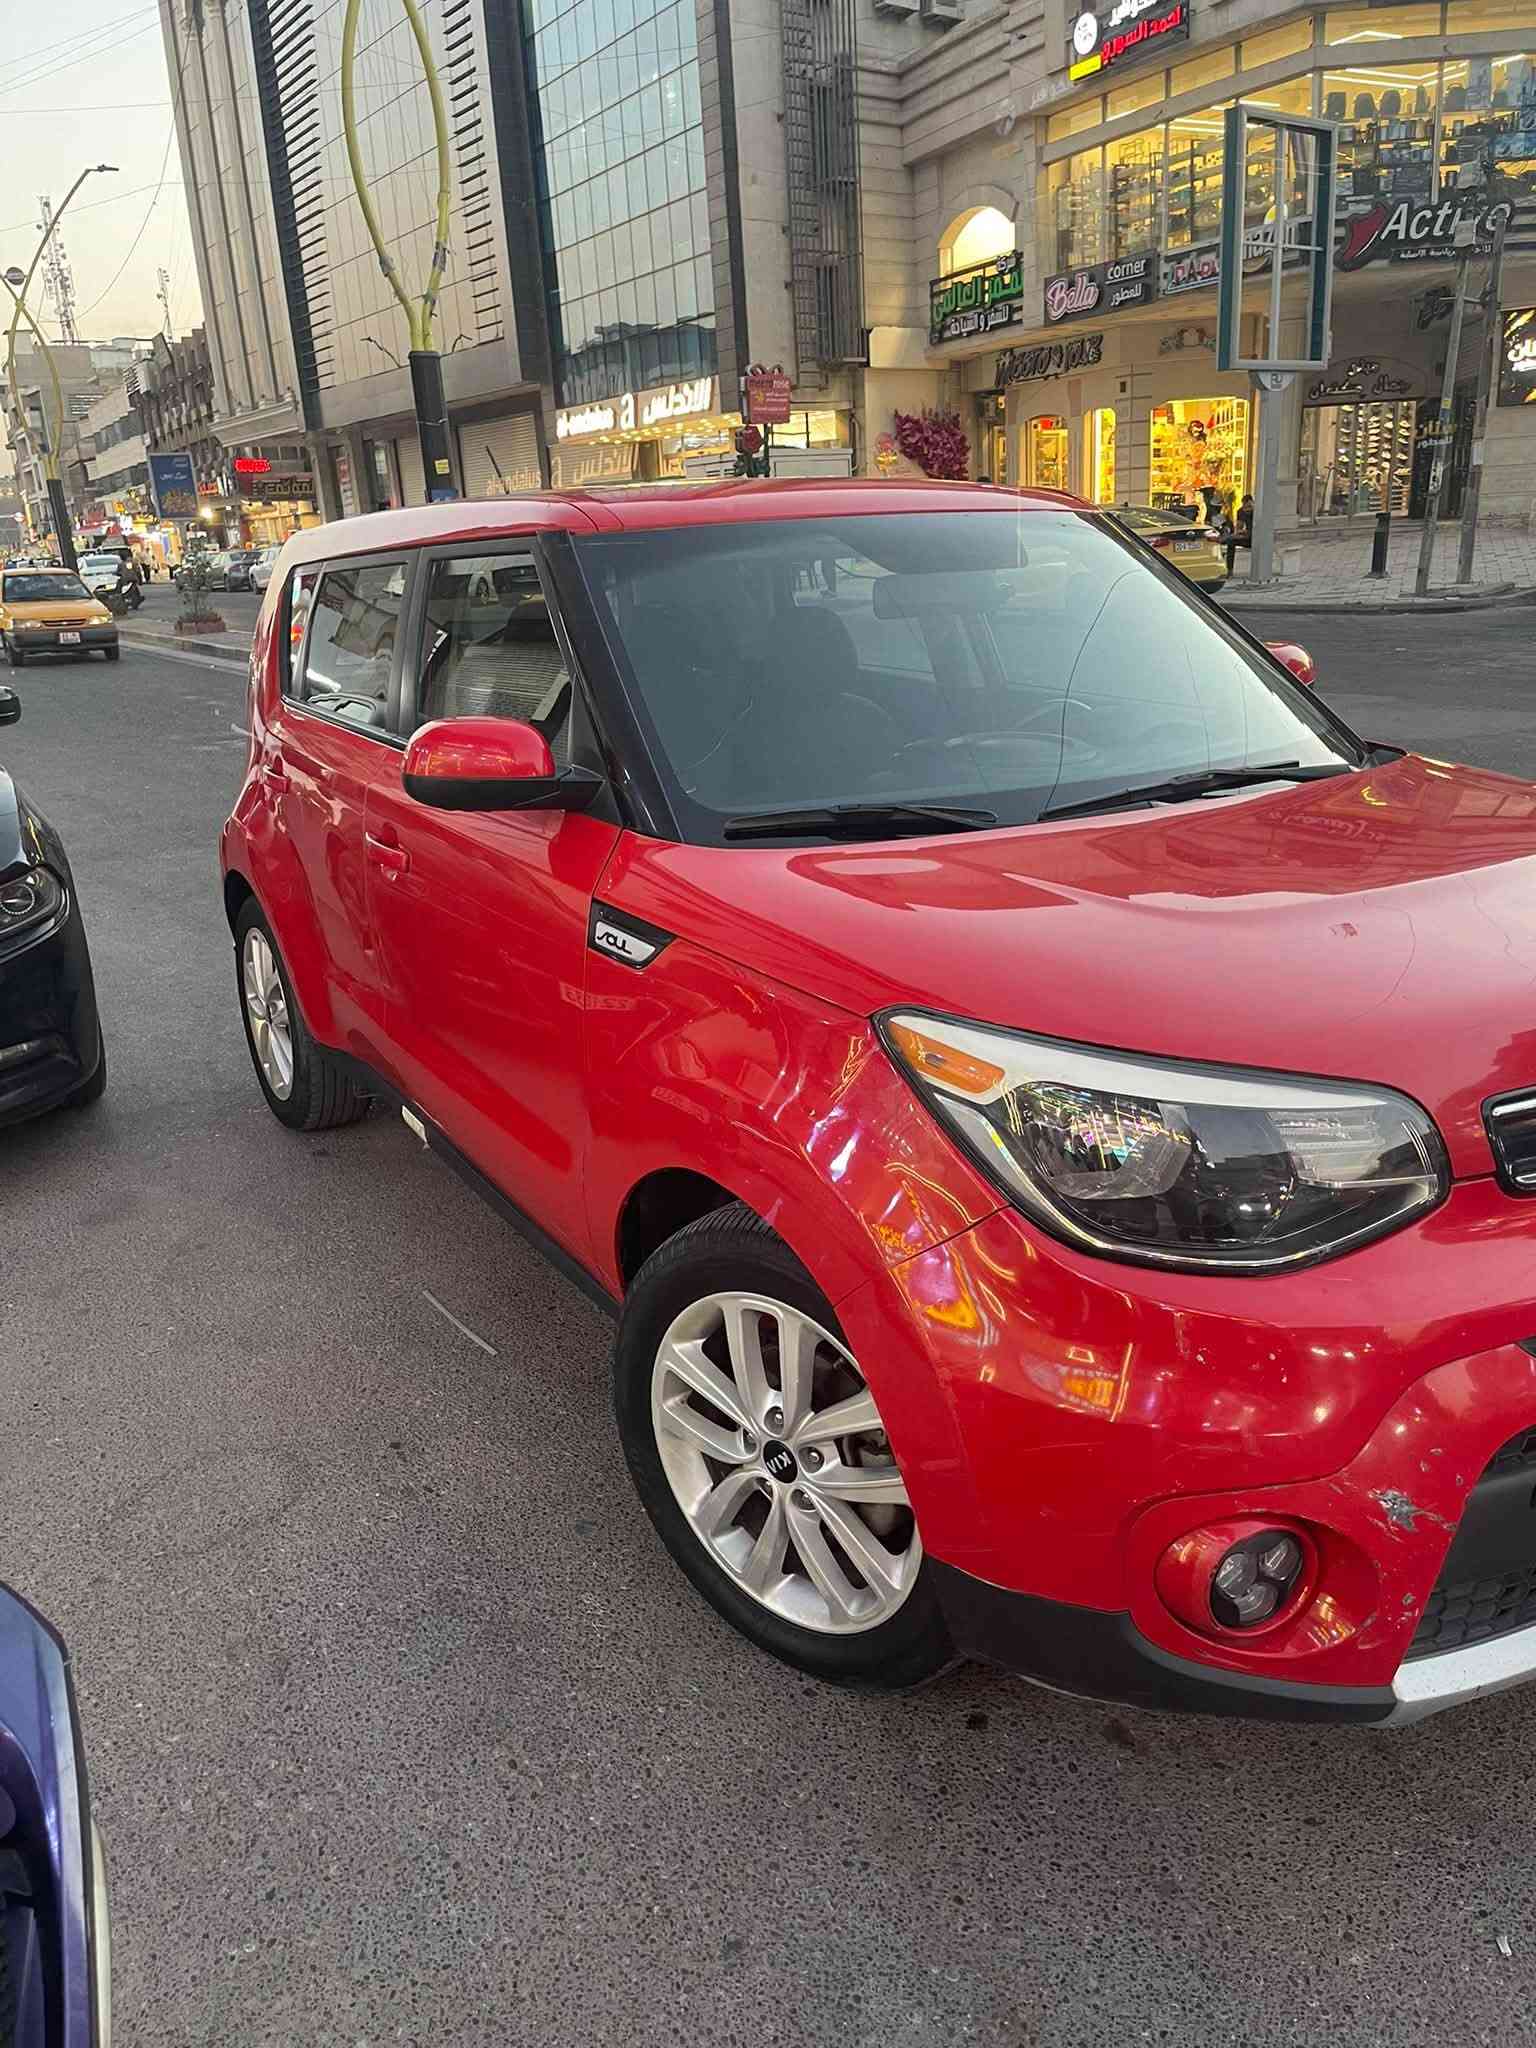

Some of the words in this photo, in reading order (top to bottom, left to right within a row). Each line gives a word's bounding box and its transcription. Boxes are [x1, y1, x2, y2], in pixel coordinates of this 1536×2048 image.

[1047, 272, 1099, 320] Bella
[1107, 259, 1146, 280] corner
[620, 392, 636, 431] a
[766, 1451, 792, 1473] KIA
